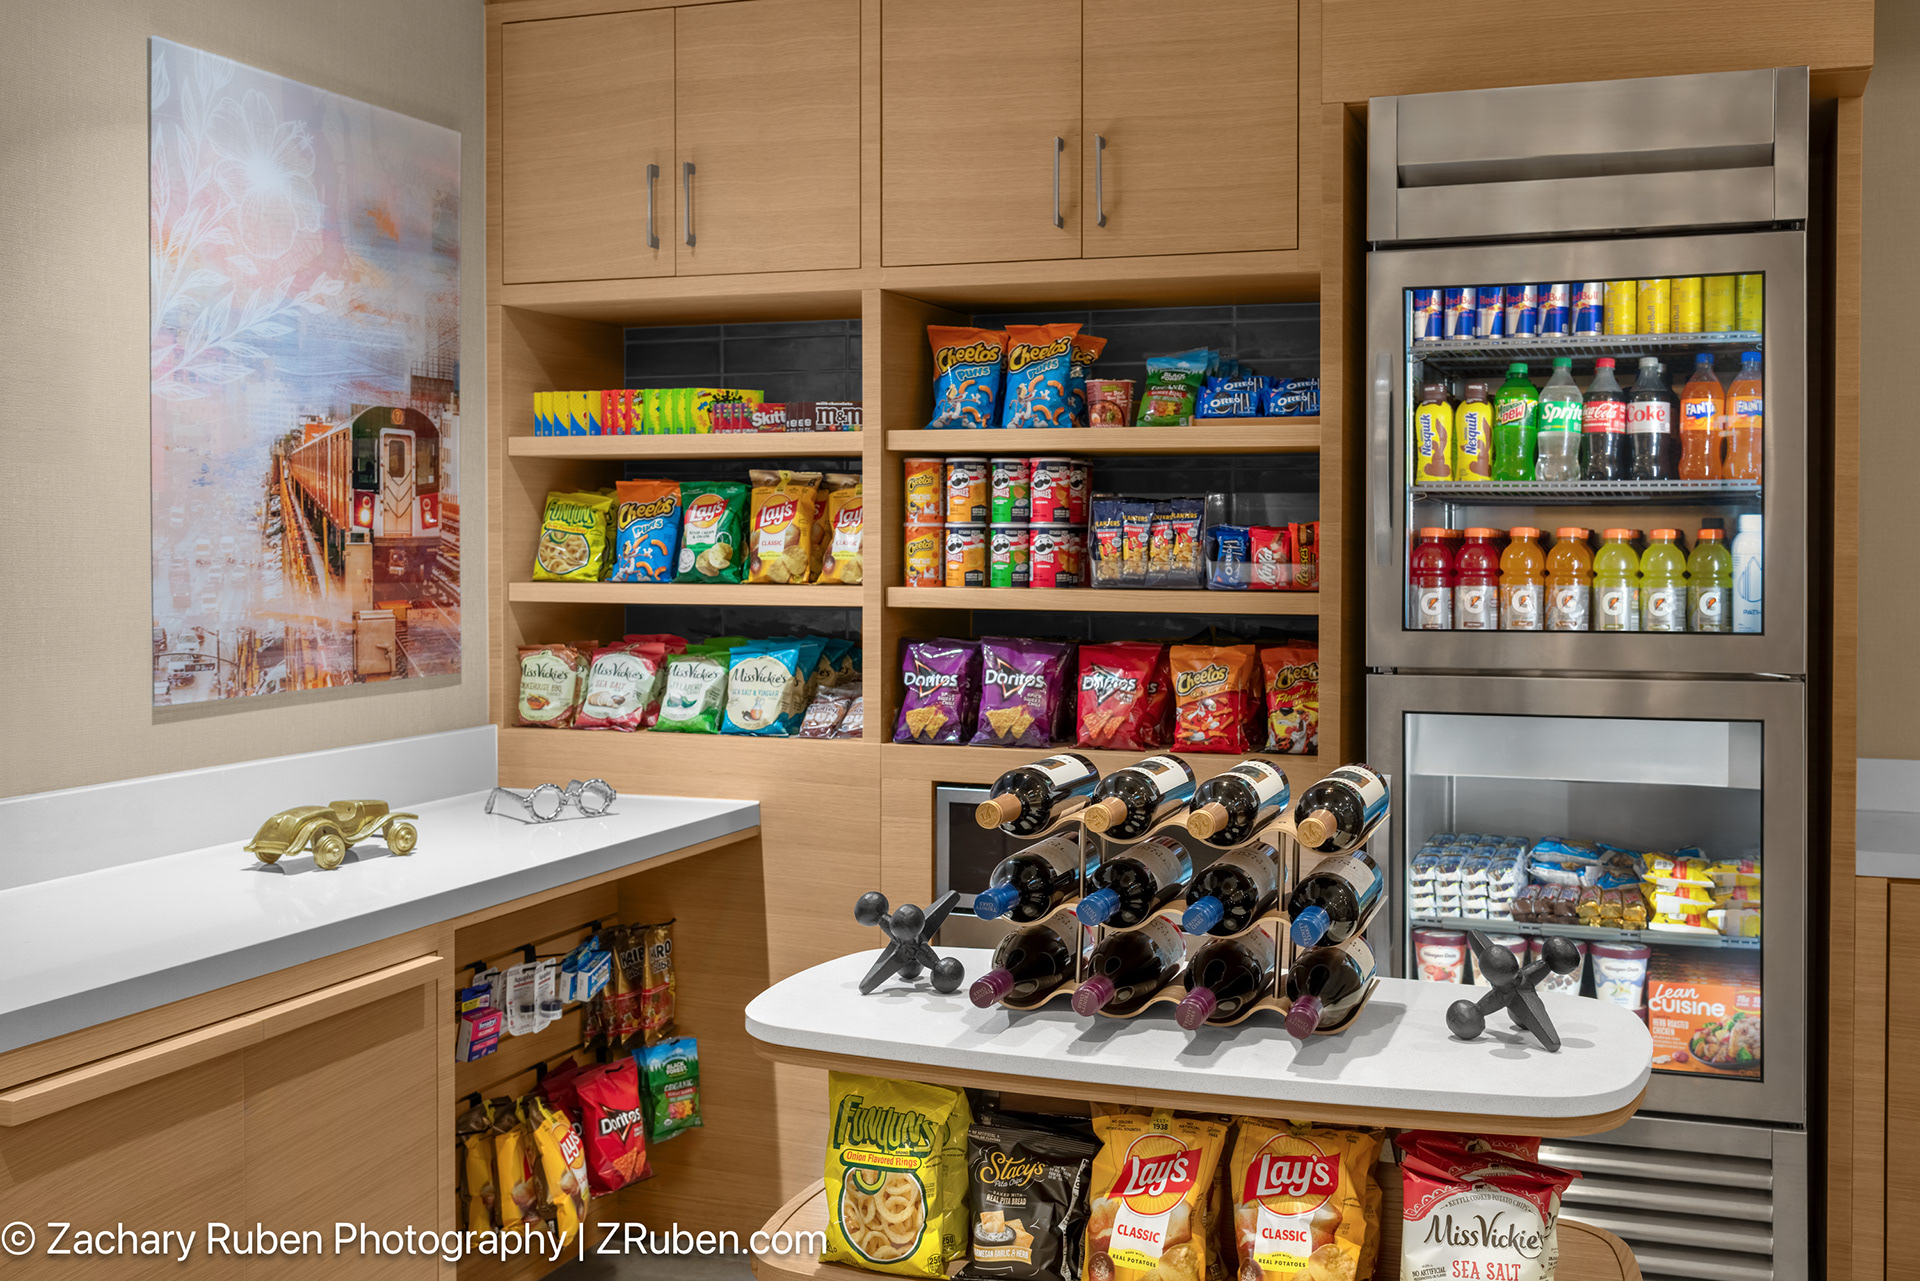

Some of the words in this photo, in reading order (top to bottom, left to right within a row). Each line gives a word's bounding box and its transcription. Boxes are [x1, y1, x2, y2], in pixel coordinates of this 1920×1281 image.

[1480, 295, 1497, 305] Red
[1549, 293, 1566, 302] Bull
[1581, 291, 1599, 300] Bull
[937, 343, 1000, 373] Cheetos
[1009, 337, 1070, 372] Cheetos
[1223, 380, 1254, 391] OREO
[1286, 380, 1317, 390] OREO
[1210, 397, 1240, 408] OREO
[1277, 395, 1308, 406] OREO
[1736, 399, 1762, 412] FANT
[752, 410, 785, 427] Skitt
[816, 406, 863, 426] m&m
[1542, 403, 1583, 423] Sprite
[1627, 405, 1666, 423] Coke
[1420, 414, 1432, 456] Nesquik
[1465, 412, 1478, 455] Nesquik
[908, 475, 934, 492] Cheetos
[619, 497, 675, 530] Cheetos
[690, 501, 724, 522] Lay's
[760, 501, 793, 528] Lay's
[837, 508, 863, 528] Lay
[908, 540, 934, 556] Cheetos
[1225, 546, 1234, 576] OREO
[1421, 592, 1442, 616] G
[1464, 590, 1484, 614] G
[1512, 589, 1537, 613] G
[1556, 589, 1577, 614] G
[1602, 591, 1624, 616] G
[1648, 592, 1670, 617] G
[1700, 592, 1721, 616] G
[595, 680, 608, 688] SEA
[611, 681, 627, 690] SALT
[904, 672, 958, 687] Doritos
[985, 669, 1045, 688] Doritos
[1178, 667, 1228, 694] Cheetos
[1277, 664, 1319, 688] Cheeto
[1655, 984, 1699, 1000] Lean
[1653, 1026, 1675, 1036] CHICKEN
[664, 1079, 693, 1091] ORGANIC
[601, 1107, 640, 1135] Doritos
[846, 1151, 867, 1162] Onion
[868, 1153, 894, 1166] Flavored
[895, 1157, 918, 1168] Rings
[980, 1152, 1045, 1186] Stacy's
[1122, 1150, 1189, 1196] Lay's
[1256, 1153, 1330, 1197] Lay's
[986, 1194, 1000, 1203] REAL
[1011, 1197, 1027, 1205] BREAD
[1448, 1196, 1470, 1208] KETTLE
[1470, 1193, 1491, 1201] COOKED
[1492, 1194, 1512, 1204] POTATO
[1512, 1200, 1530, 1211] CHIPS
[1117, 1224, 1160, 1243] CLASSIC
[1262, 1227, 1307, 1242] CLASSIC
[994, 1249, 1011, 1258] GARLIC
[1016, 1249, 1029, 1259] HERB
[1112, 1254, 1126, 1262] REAL
[1127, 1256, 1156, 1268] POTATOES
[1274, 1259, 1306, 1268] POTATOES
[1420, 1266, 1446, 1277] ARTIFICIAL
[1452, 1260, 1480, 1280] SEA
[1486, 1262, 1521, 1281] SALT
